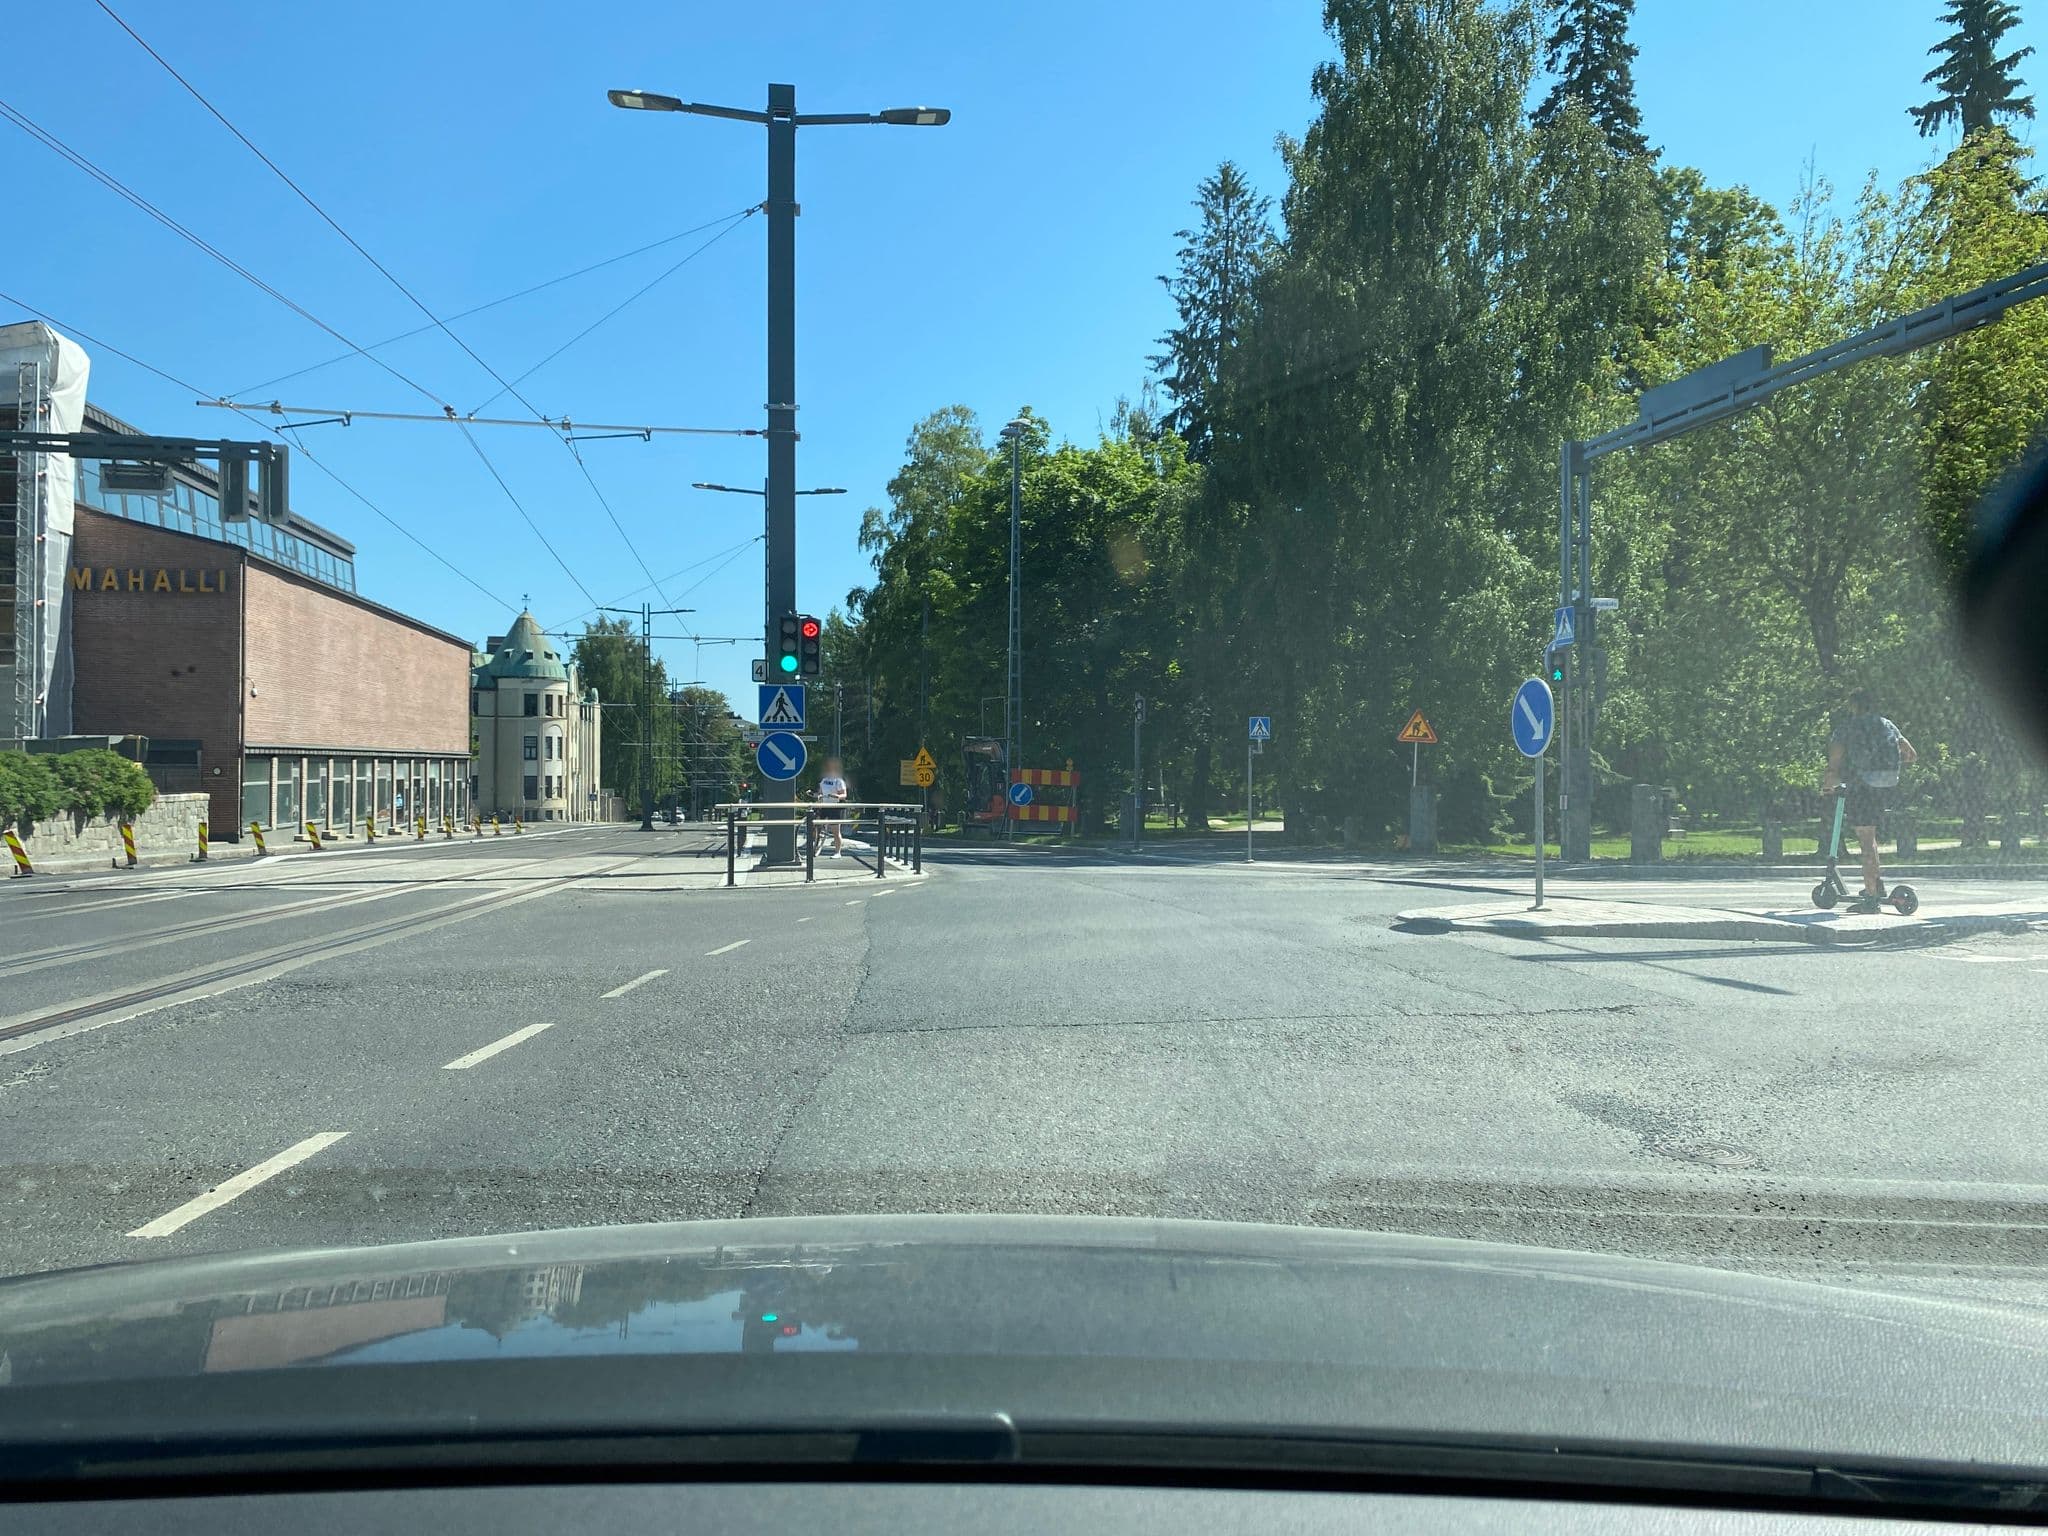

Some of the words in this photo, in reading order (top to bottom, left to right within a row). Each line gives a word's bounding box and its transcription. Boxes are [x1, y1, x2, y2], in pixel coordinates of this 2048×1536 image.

[69, 567, 226, 592] MAHALLI
[755, 664, 764, 678] 4
[919, 773, 931, 782] 30
